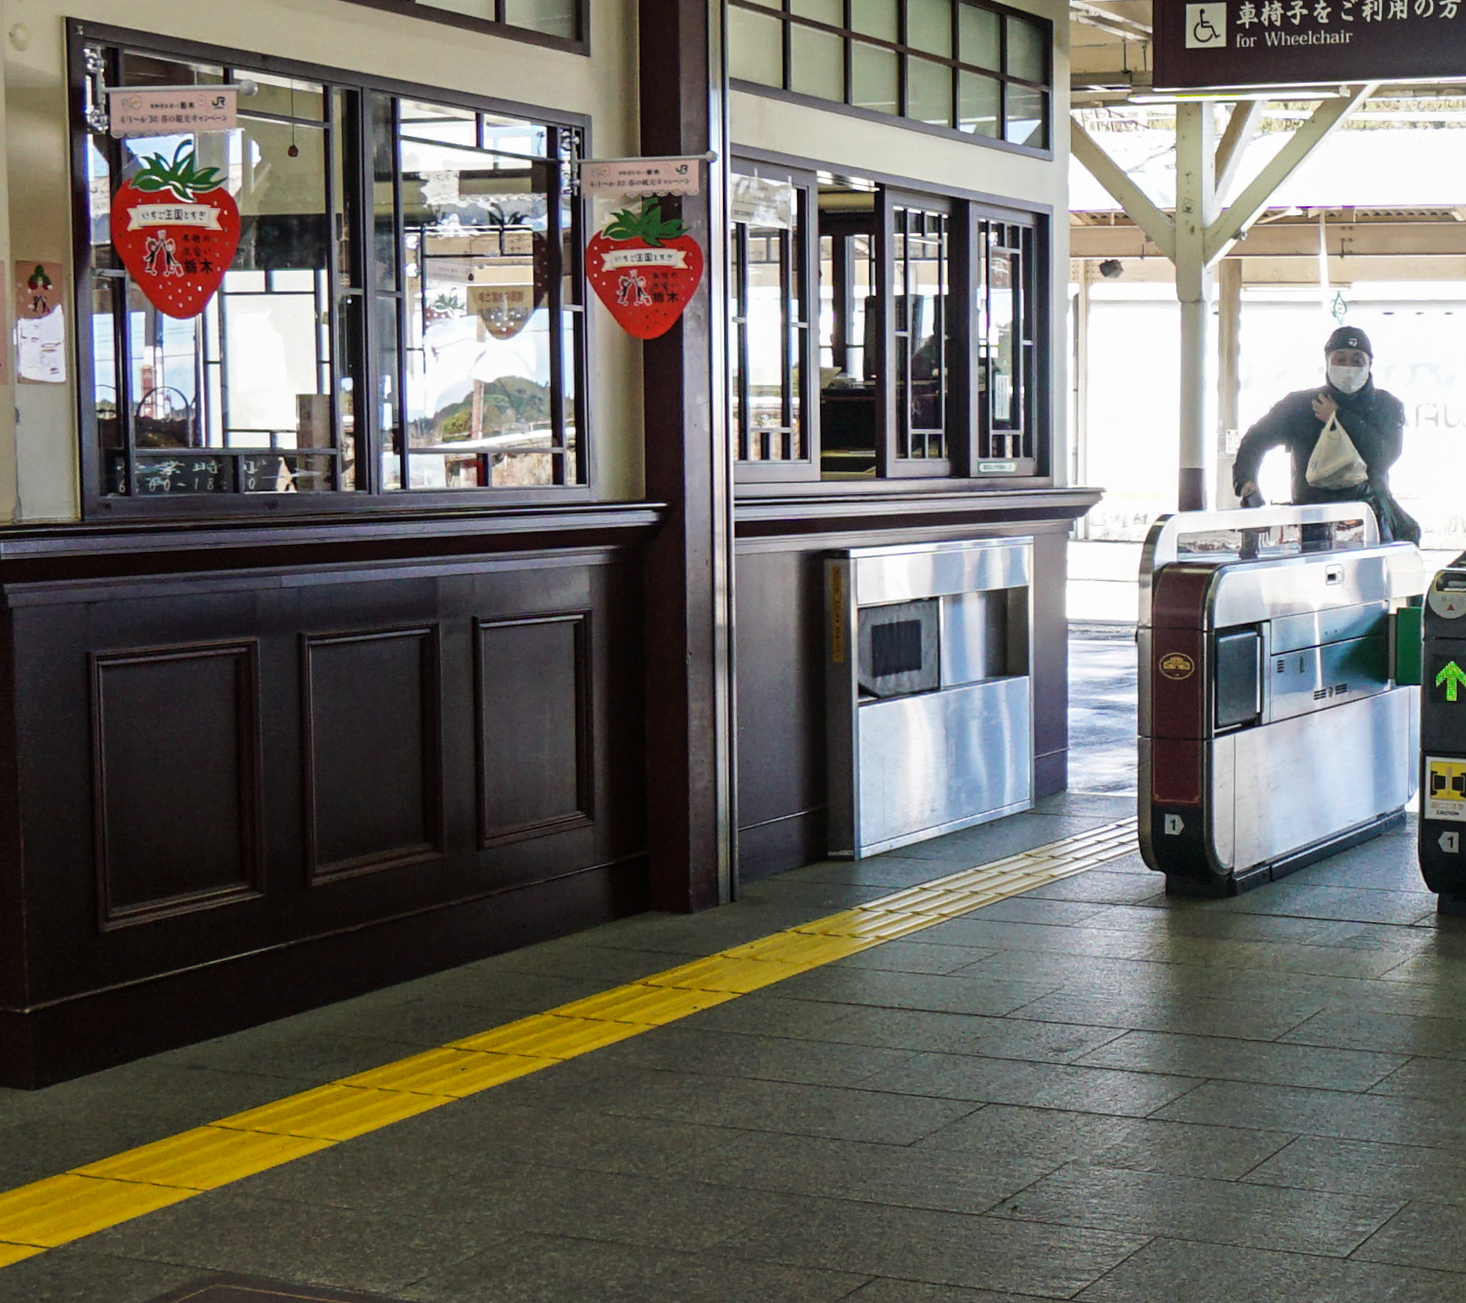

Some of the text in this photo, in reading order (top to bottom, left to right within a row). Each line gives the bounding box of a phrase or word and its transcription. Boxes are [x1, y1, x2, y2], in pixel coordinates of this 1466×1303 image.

[1236, 29, 1354, 49] for Wheelchair
[212, 96, 226, 107] JR
[184, 258, 214, 275] 栃木
[1170, 818, 1176, 831] 1
[1447, 836, 1453, 848] 1
